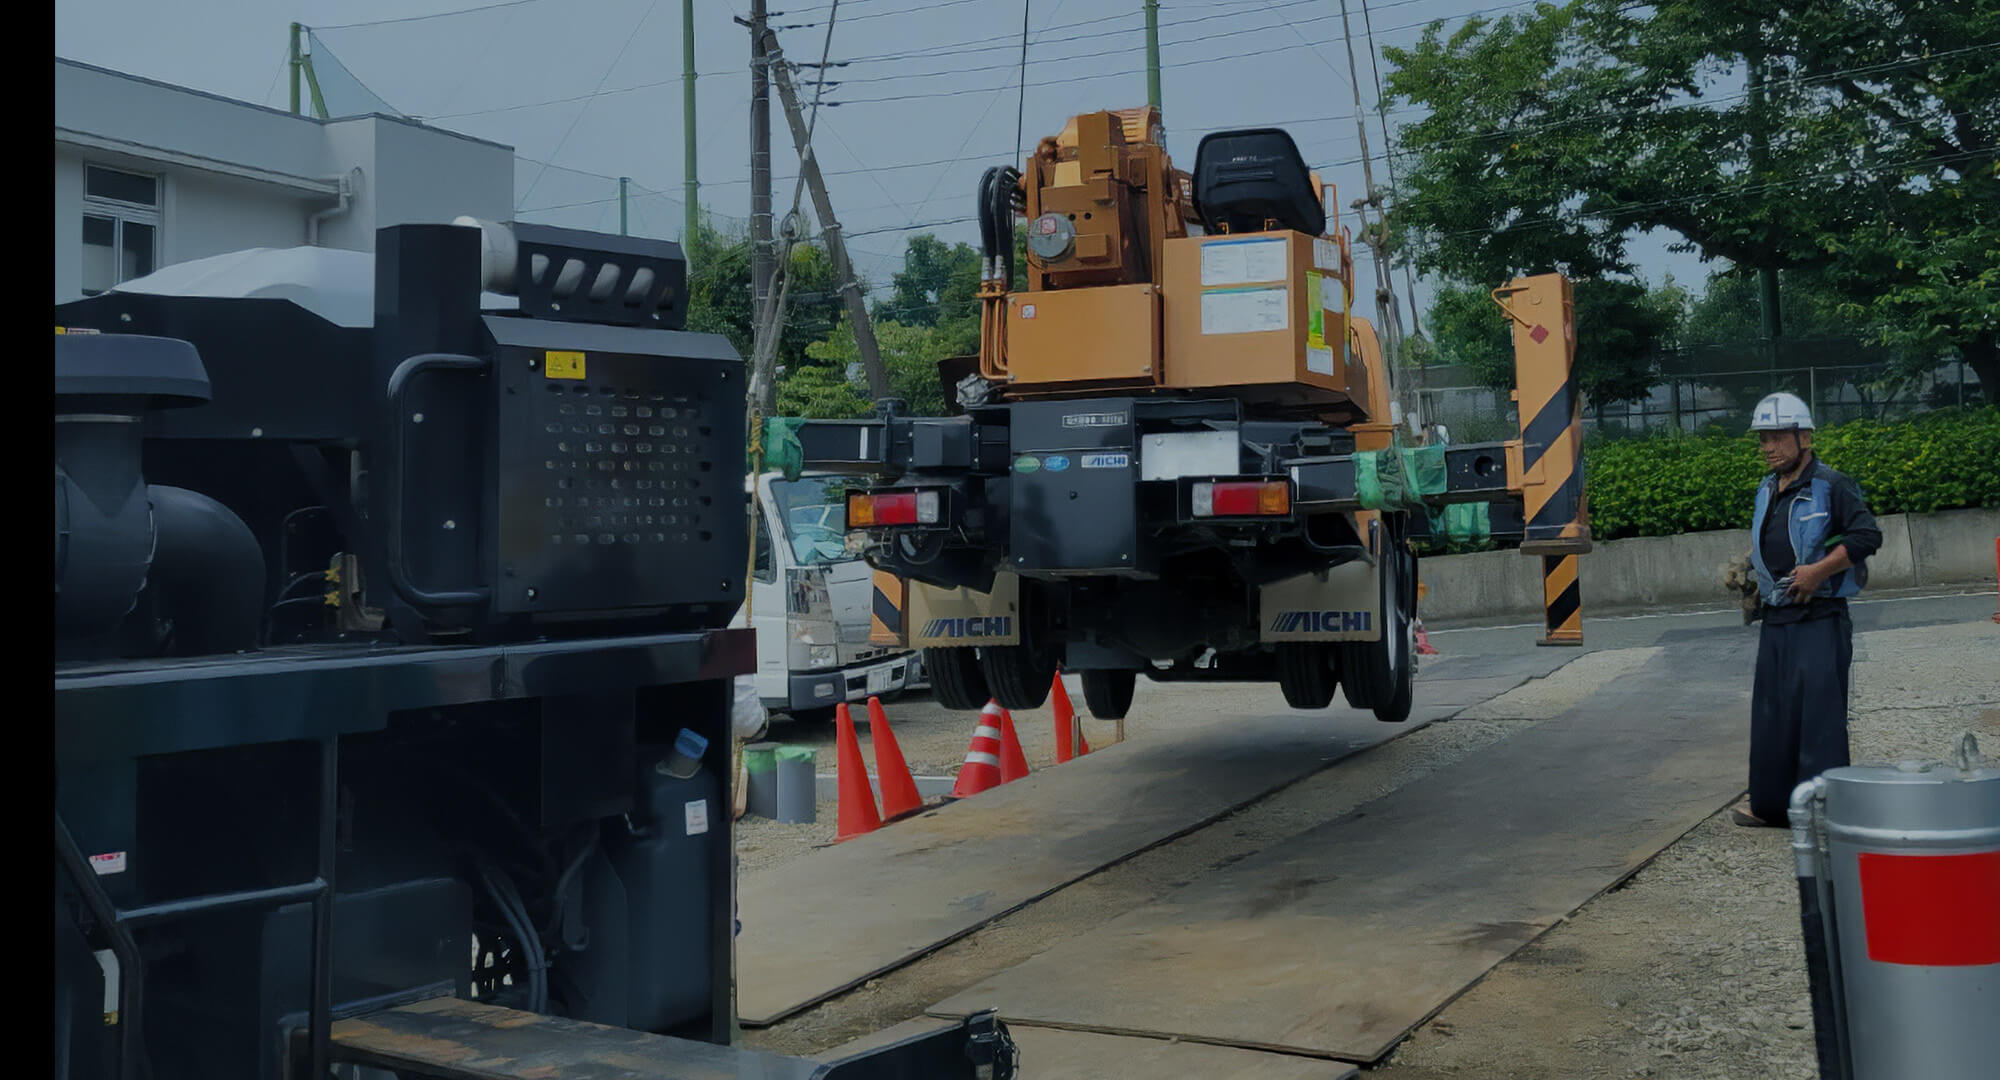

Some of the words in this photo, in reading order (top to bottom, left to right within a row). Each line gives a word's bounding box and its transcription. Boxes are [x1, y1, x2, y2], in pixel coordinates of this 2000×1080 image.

[1089, 456, 1126, 466] AICHI
[920, 616, 1011, 638] AICHI
[1270, 611, 1371, 633] AICHI
